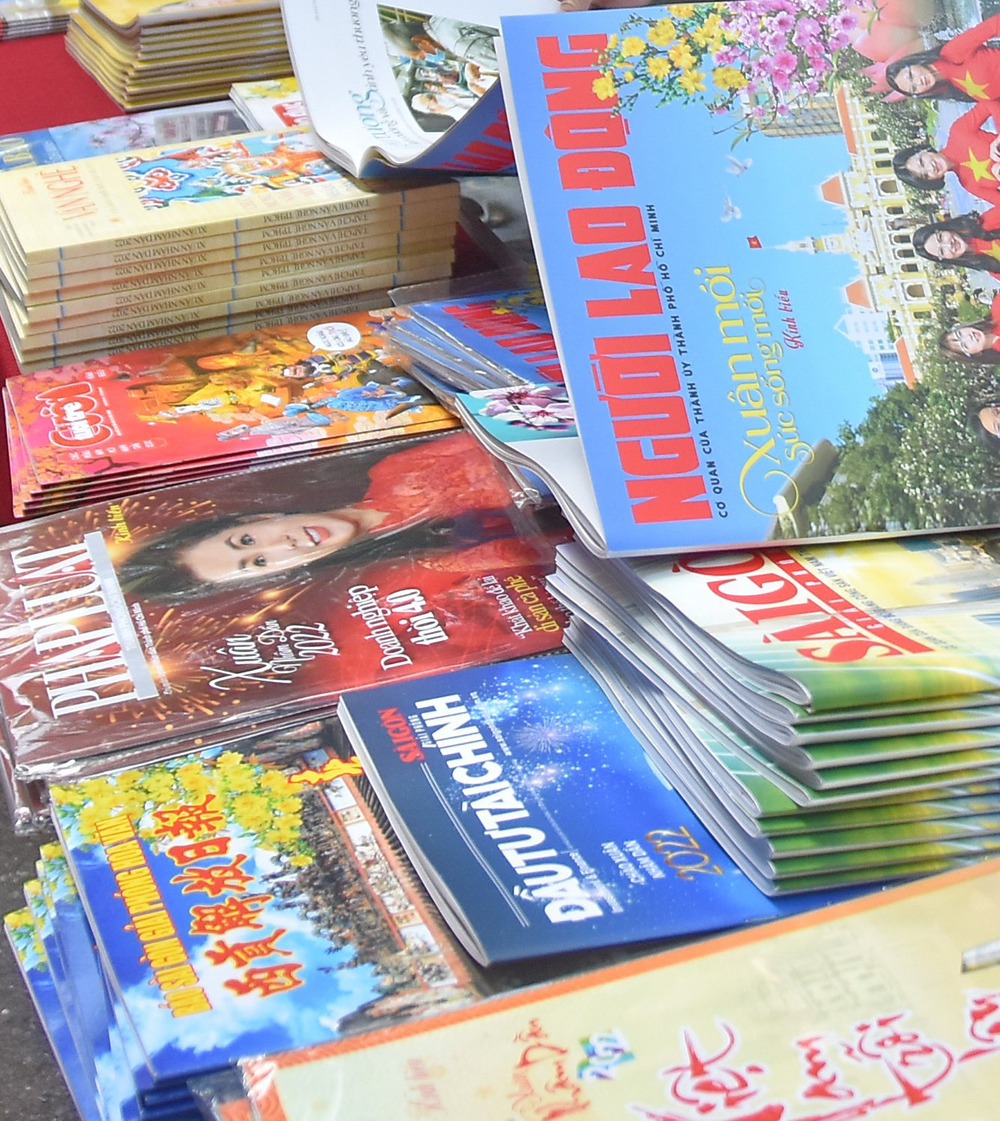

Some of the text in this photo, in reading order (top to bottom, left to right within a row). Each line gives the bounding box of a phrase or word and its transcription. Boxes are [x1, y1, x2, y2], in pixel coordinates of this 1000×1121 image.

[646, 205, 660, 232] MINH
[651, 237, 665, 257] CHÍ
[536, 33, 713, 523] NGƯỜI LAO ĐỘNG
[661, 282, 677, 309] PHỐ
[739, 277, 772, 338] mới
[671, 316, 688, 355] THÀNH
[693, 265, 799, 518] Xuân mới
[756, 341, 790, 407] sống
[687, 383, 705, 424] THÀNH
[699, 430, 712, 455] CỦA
[706, 461, 723, 495] QUAN
[716, 502, 728, 518] CƠ
[673, 551, 903, 663] SÀIGÒ
[285, 622, 340, 656] 2022
[346, 584, 413, 671] Doanh nghiệp
[399, 611, 449, 645] thời
[106, 839, 147, 872] HOA
[645, 825, 725, 881] 2022
[113, 866, 164, 915] PHÓNG
